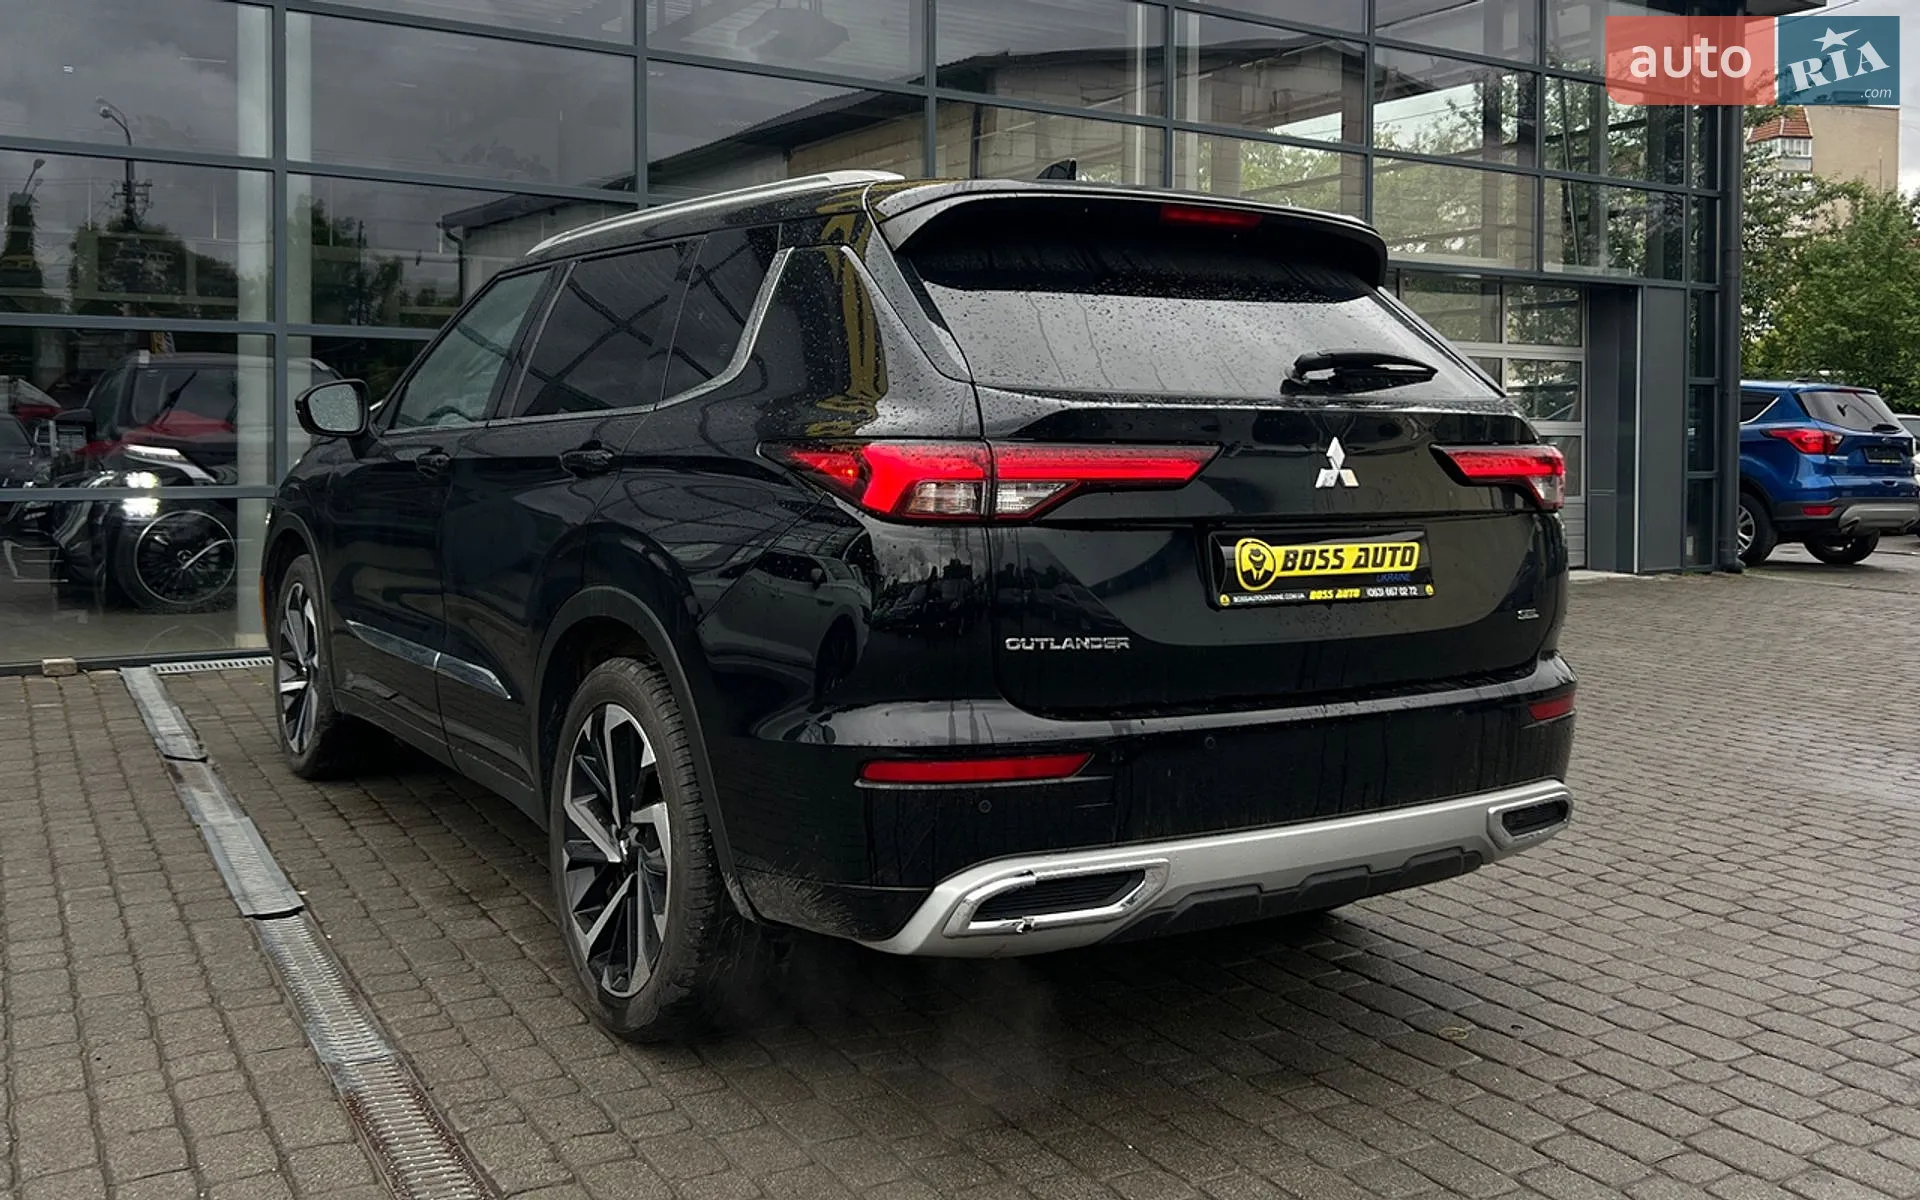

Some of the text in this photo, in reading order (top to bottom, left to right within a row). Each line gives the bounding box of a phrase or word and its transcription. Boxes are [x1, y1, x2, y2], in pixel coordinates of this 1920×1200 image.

[1281, 545, 1416, 571] BOSS AUTO
[1376, 573, 1411, 583] UKRAINE
[1309, 588, 1361, 600] BOSS AUTO
[1005, 637, 1130, 651] OUTLANDER
